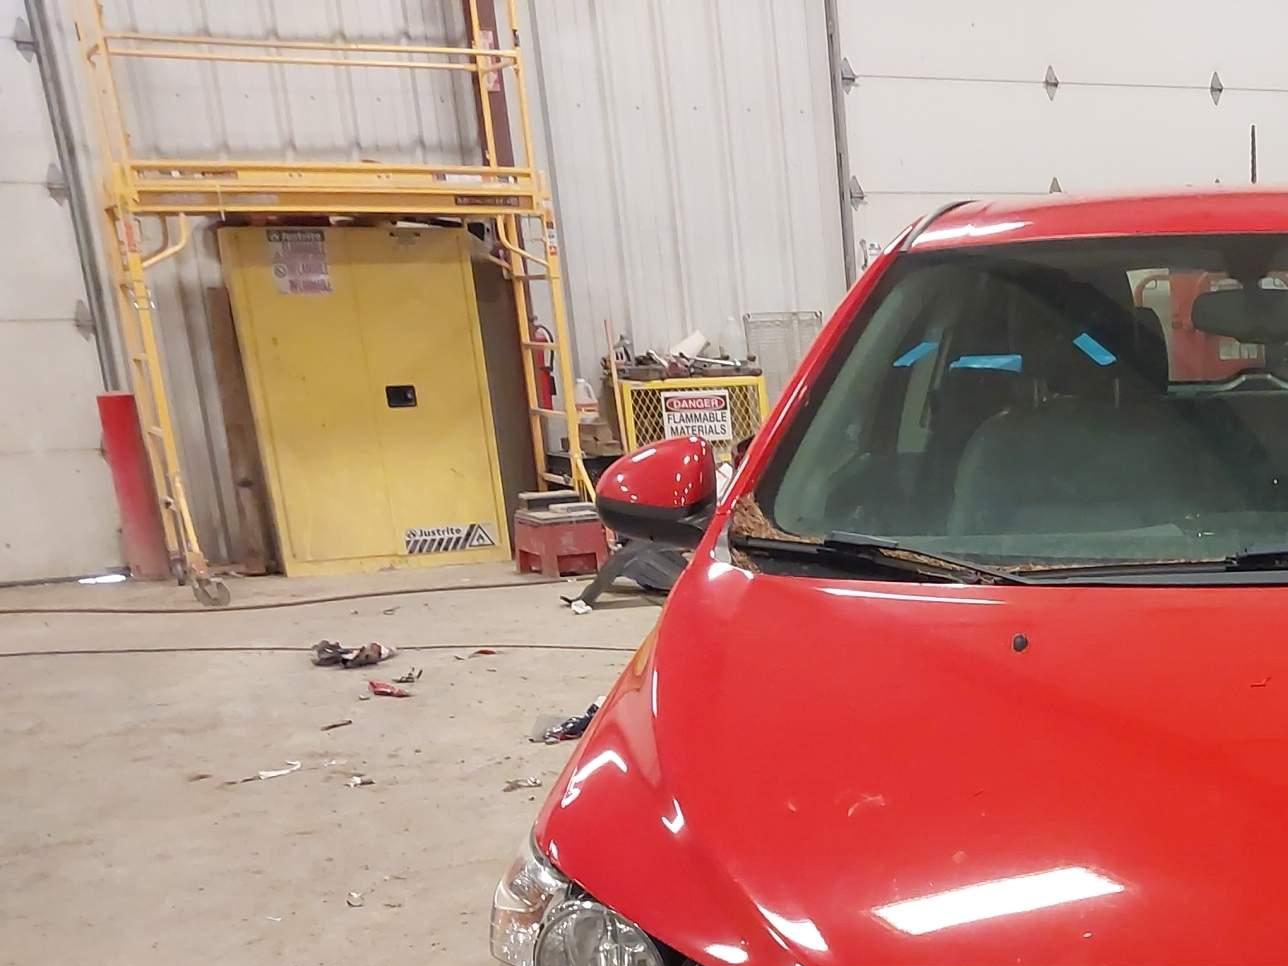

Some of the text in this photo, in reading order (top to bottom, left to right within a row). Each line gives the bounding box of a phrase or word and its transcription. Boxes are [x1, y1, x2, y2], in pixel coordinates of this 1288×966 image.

[672, 398, 719, 409] DANGER
[667, 411, 727, 424] FLAMMABLE
[670, 424, 727, 437] MATERIALS
[419, 526, 462, 538] Justrite
